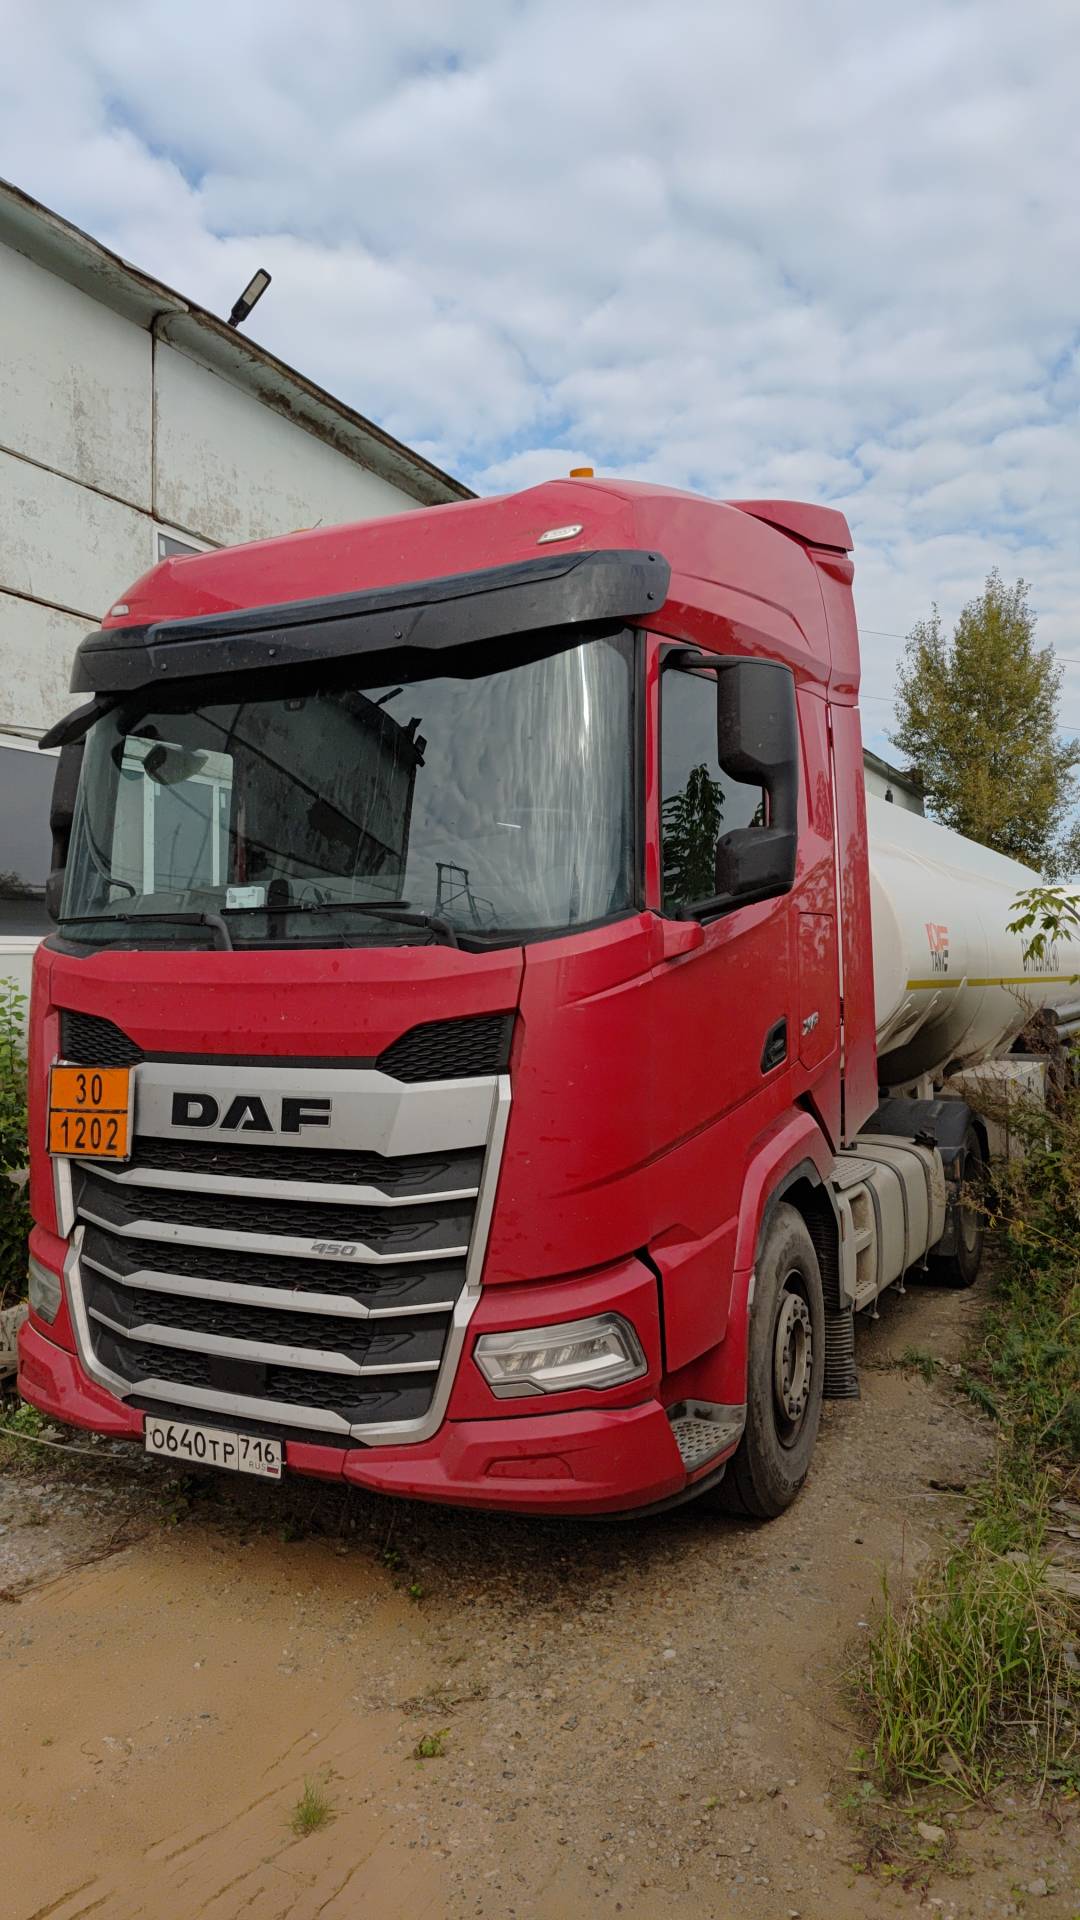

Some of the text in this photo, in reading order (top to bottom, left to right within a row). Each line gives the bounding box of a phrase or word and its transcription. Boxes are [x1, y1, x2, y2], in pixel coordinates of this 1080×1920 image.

[76, 1073, 103, 1105] 30
[171, 1091, 332, 1134] DAF
[61, 1116, 118, 1150] 1202
[311, 1243, 358, 1256] 450
[248, 1460, 267, 1472] RUS
